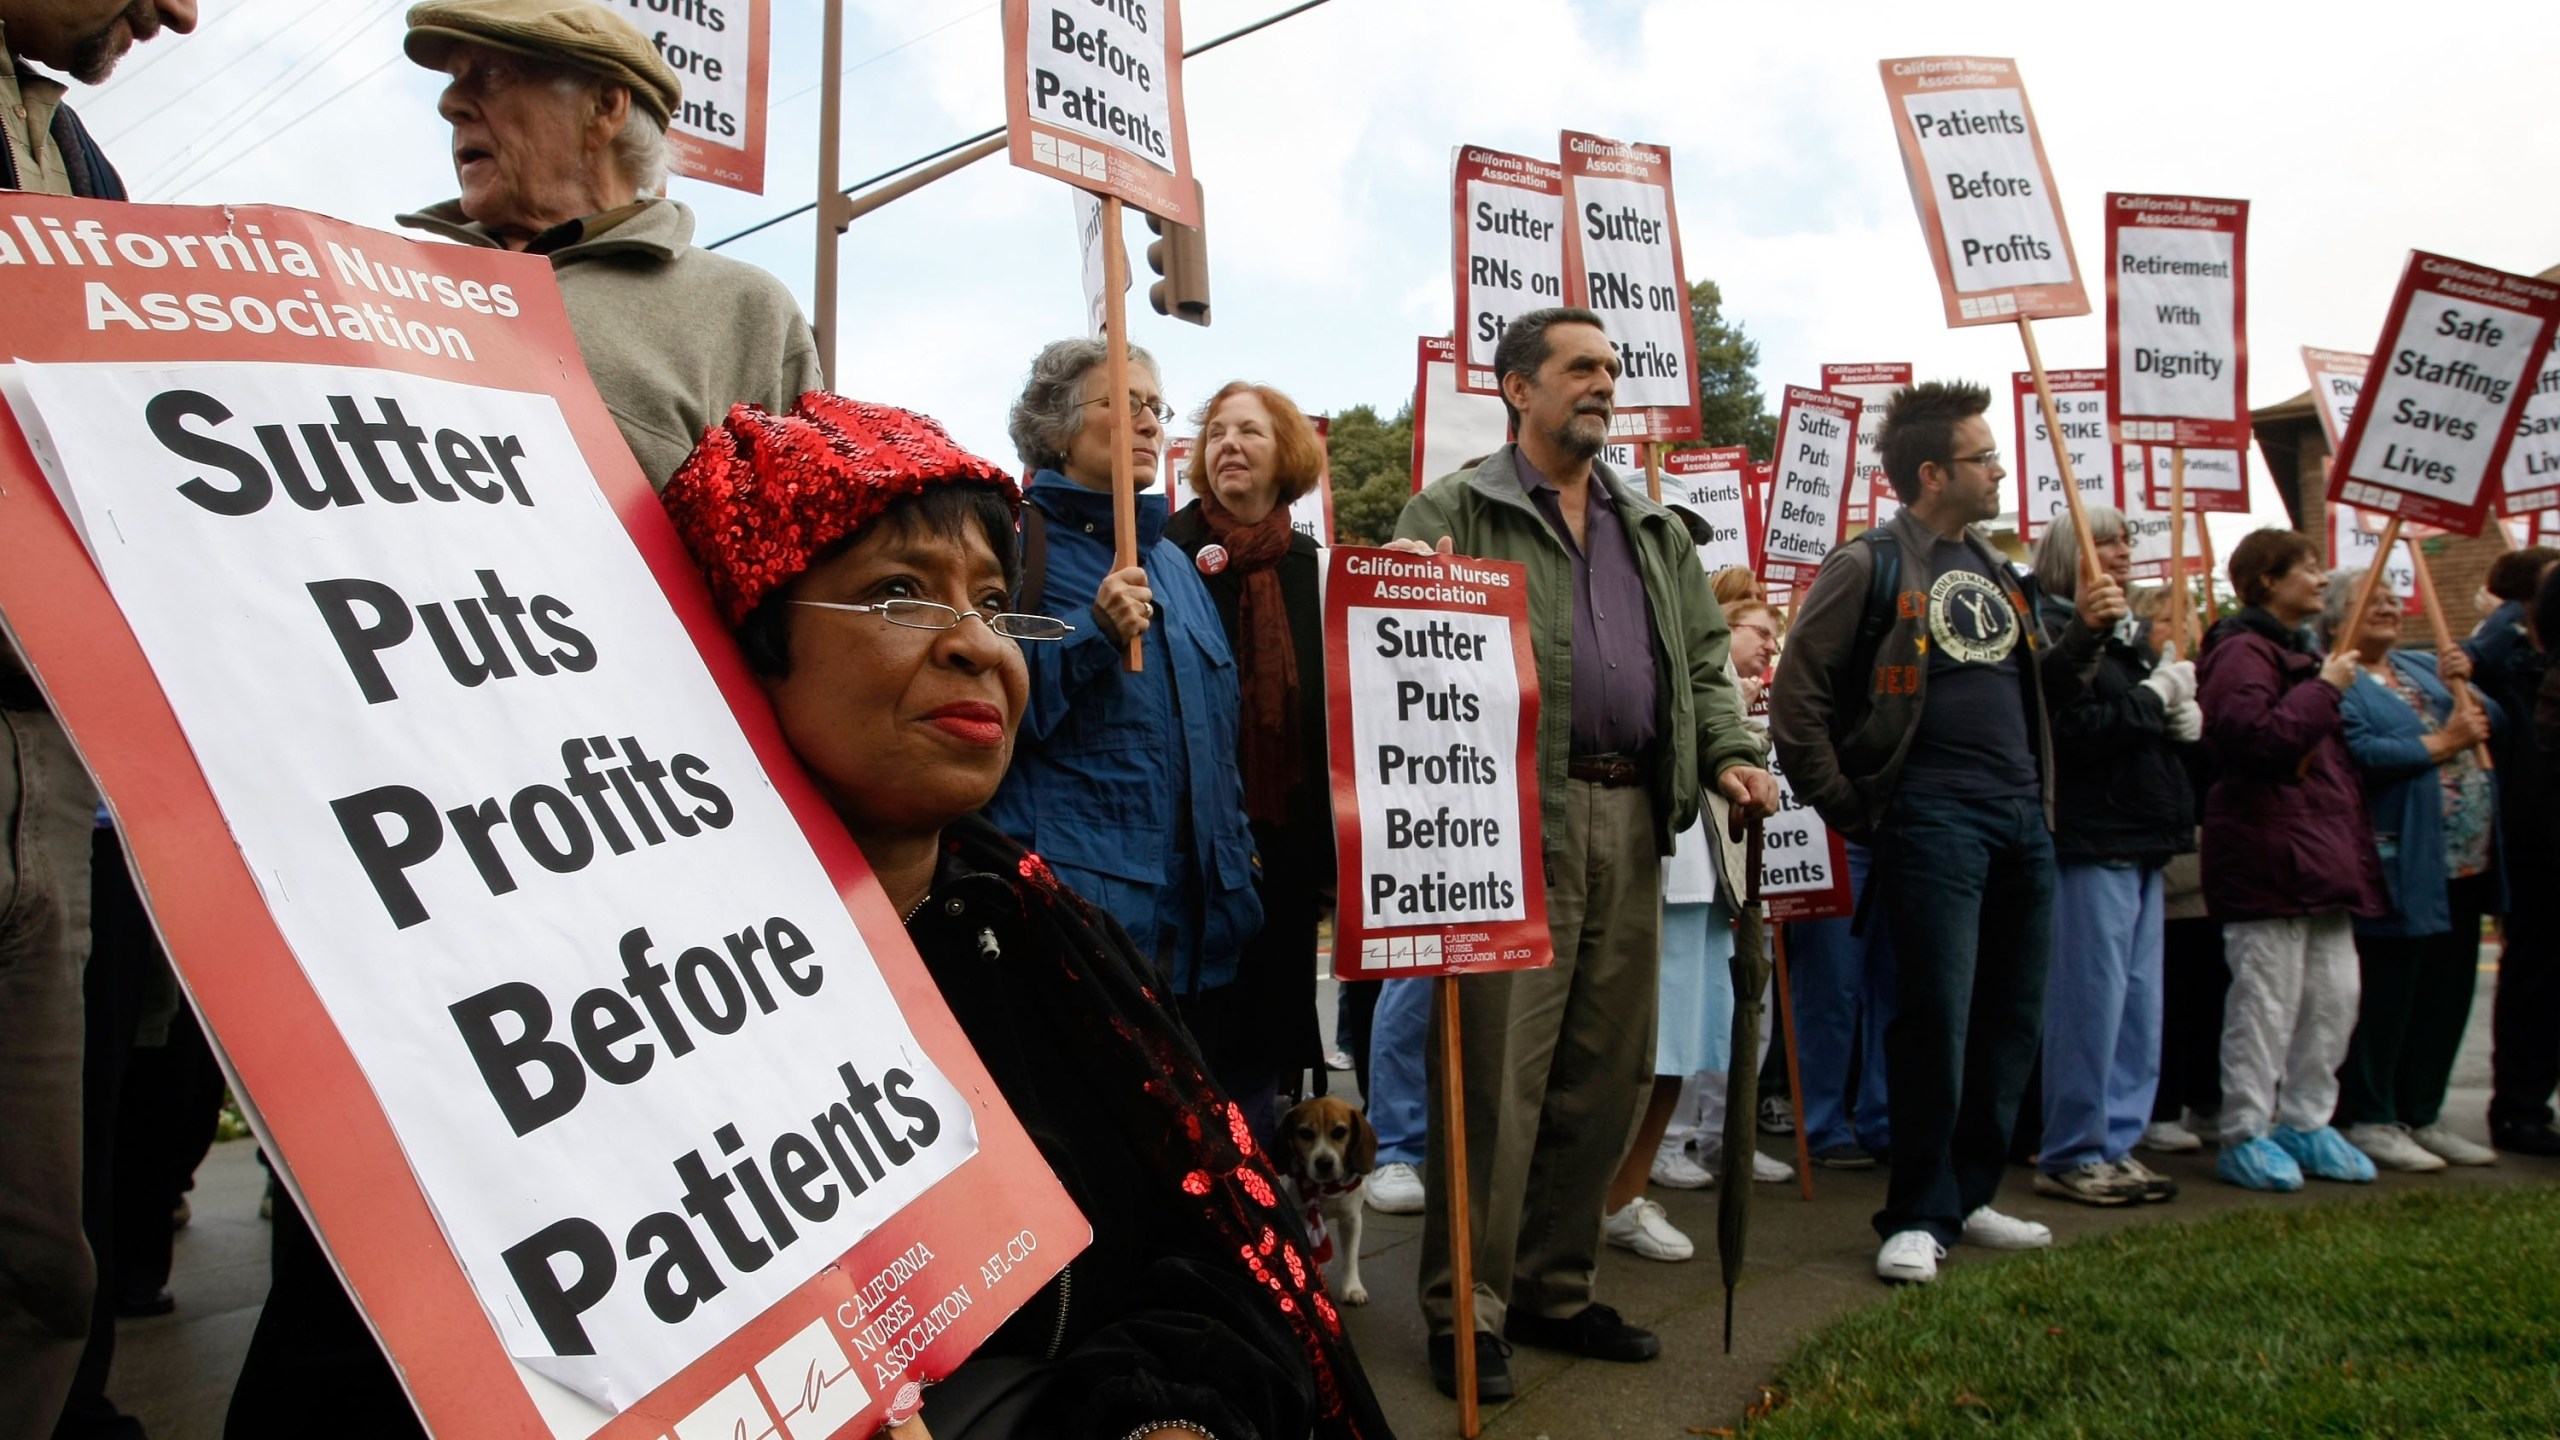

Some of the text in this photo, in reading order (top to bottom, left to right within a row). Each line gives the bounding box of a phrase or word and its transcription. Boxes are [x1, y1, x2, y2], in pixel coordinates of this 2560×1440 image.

[652, 31, 723, 82] fore
[1052, 8, 1150, 92] Before
[1892, 60, 2010, 76] California Nurses
[1917, 72, 1996, 88] Association
[1035, 68, 1167, 158] Patients
[1915, 109, 2025, 138] Patients
[1570, 137, 1625, 158] California
[1468, 150, 1562, 179] California Nurses
[1481, 167, 1547, 189] Association
[1586, 156, 1648, 177] Association
[1946, 170, 2032, 200] Before
[1475, 201, 1554, 242] Sutter
[2116, 197, 2238, 216] California Nurses
[2136, 211, 2218, 227] Association
[1584, 202, 1662, 245] Sutter
[1961, 234, 2052, 267] Profits
[0, 214, 520, 318] alifornia Nurses
[1471, 254, 1559, 297] RNs on
[2122, 254, 2229, 279] Retirement
[2421, 258, 2559, 301] California Nurses
[1588, 272, 1676, 312] RNs on
[2438, 278, 2530, 308] Association
[85, 281, 475, 361] Association
[2156, 304, 2200, 326] With
[2436, 309, 2503, 347] Safe
[1827, 364, 1906, 374] California Nurses
[1840, 374, 1894, 383] Association
[2135, 348, 2223, 381] Dignity
[2393, 349, 2513, 404] Staffing
[1791, 389, 1832, 404] California
[1832, 396, 1856, 409] Nurses
[1800, 402, 1844, 417] Association
[2078, 401, 2099, 413] on
[1798, 412, 1840, 439] Sutter
[2035, 422, 2102, 441] SRIKE
[2392, 398, 2478, 441] Saves
[145, 389, 535, 516] Sutter
[1670, 452, 1740, 464] California Nurses
[1683, 461, 1730, 471] Association
[1798, 443, 1830, 468] Puts
[2382, 444, 2457, 484] Lives
[1689, 485, 1740, 504] atients
[1785, 471, 1830, 498] Profits
[1780, 500, 1825, 526] Before
[1768, 528, 1826, 557] Patients
[1346, 556, 1510, 587] California Nurses
[1374, 581, 1487, 605] Association
[305, 569, 598, 704] Puts
[1376, 616, 1487, 661] Sutter
[1396, 680, 1480, 722] Puts
[1378, 743, 1497, 785] Profits
[329, 735, 734, 930] Profits
[1385, 806, 1500, 849] Before
[1760, 861, 1825, 889] ients
[1370, 871, 1514, 915] Patients
[1444, 933, 1490, 944] CALIFORNIA
[1445, 944, 1473, 954] NURSES
[1446, 949, 1531, 964] ASSOCIATION AFL-CIO
[447, 916, 824, 1138] Before
[500, 1061, 941, 1357] Patients
[836, 1241, 935, 1329] CALIFORNIA
[873, 1229, 1038, 1390] ASSOCIATION AFL-CIO
[850, 1295, 915, 1361] NURSES
